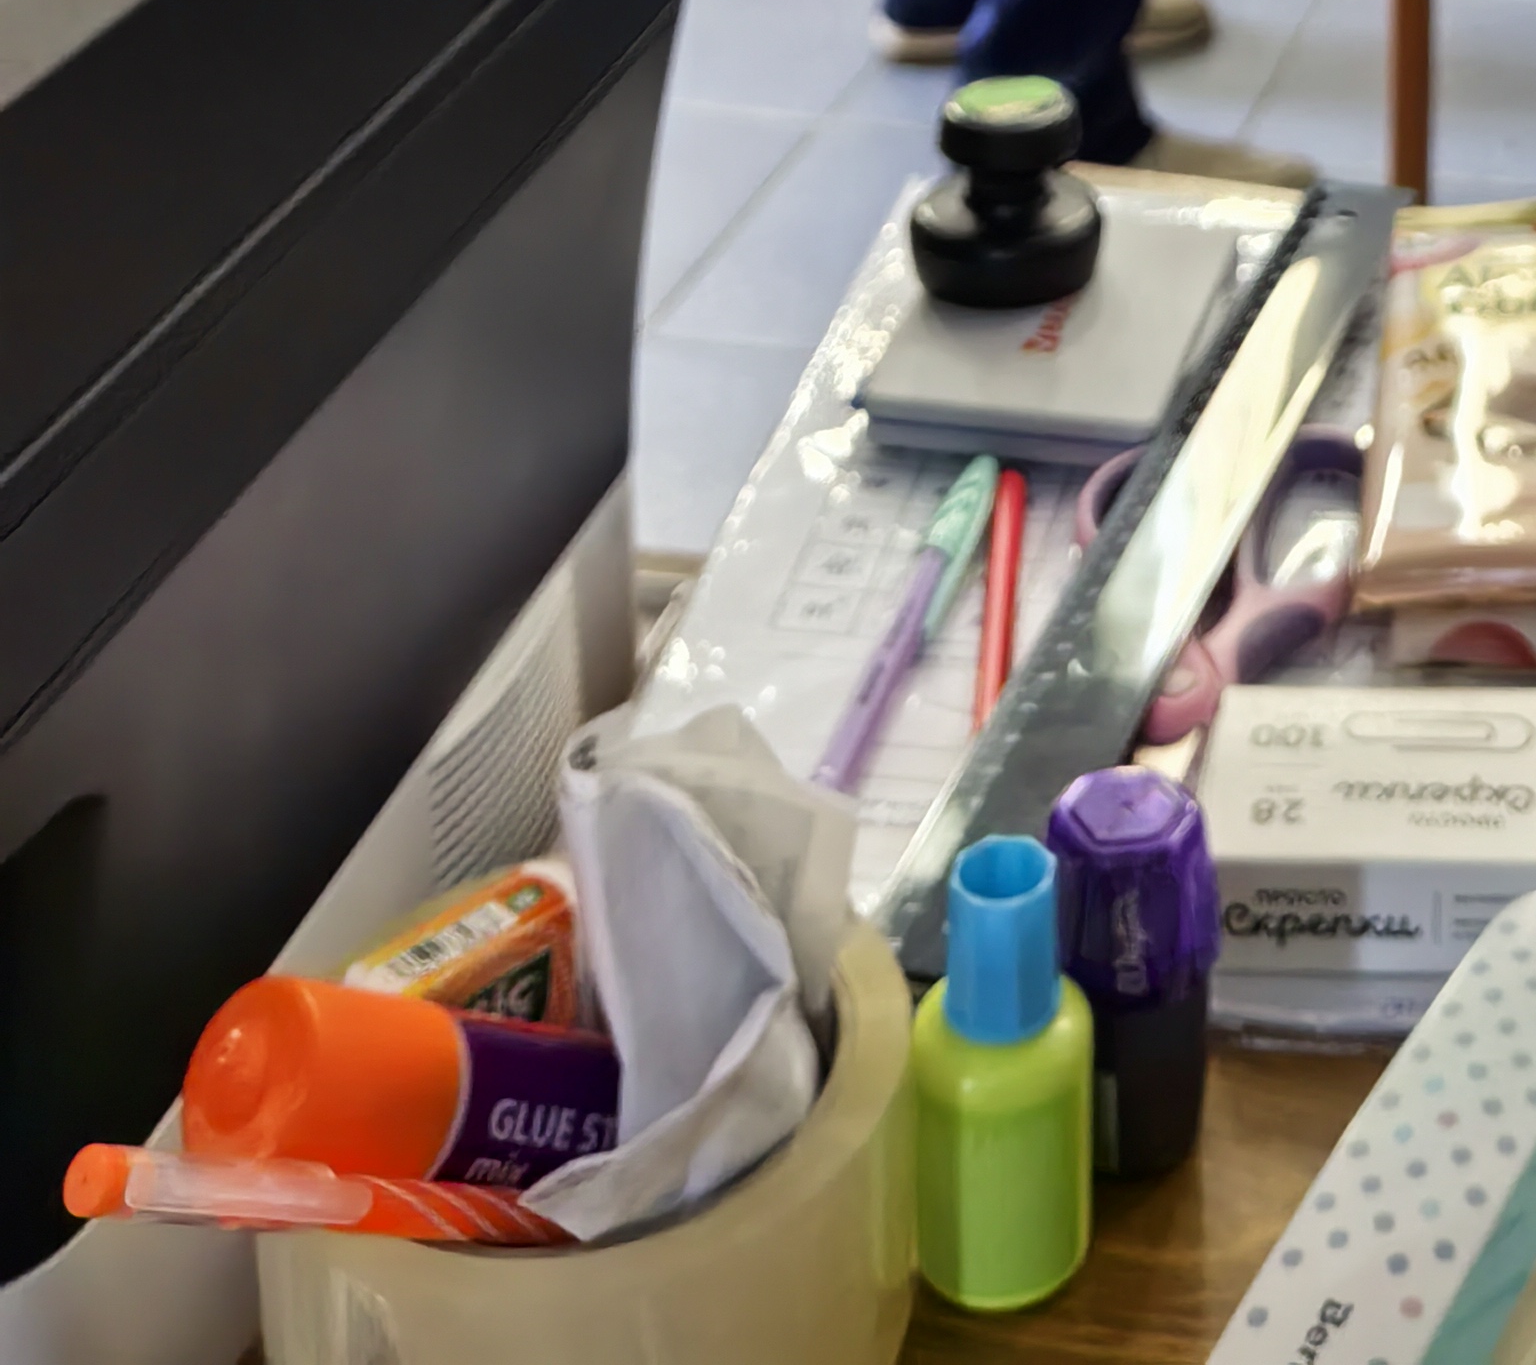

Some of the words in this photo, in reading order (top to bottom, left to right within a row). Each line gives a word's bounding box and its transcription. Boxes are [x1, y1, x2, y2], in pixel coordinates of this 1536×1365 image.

[1249, 722, 1325, 750] 100
[1249, 797, 1305, 827] 28
[1223, 901, 1422, 948] Скрепки
[488, 1097, 577, 1151] GLUE
